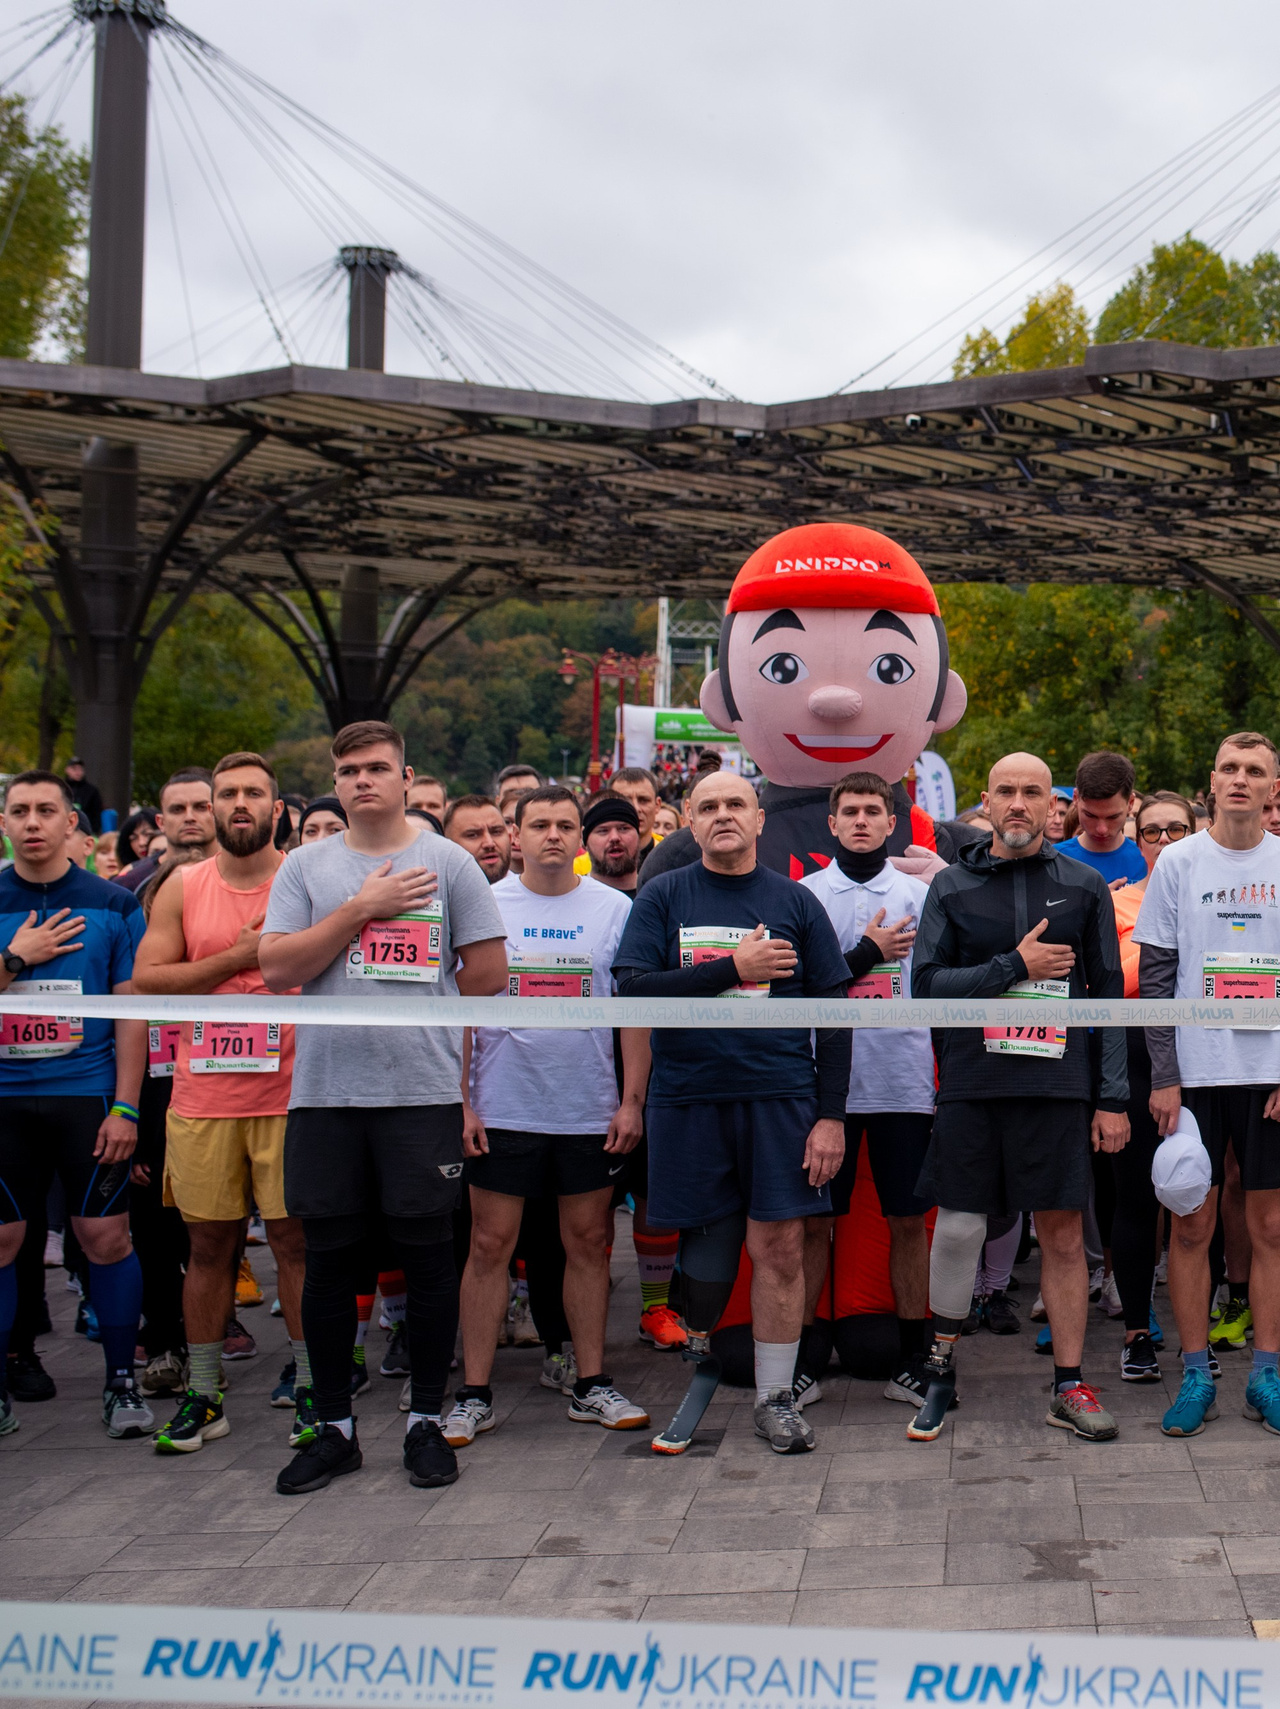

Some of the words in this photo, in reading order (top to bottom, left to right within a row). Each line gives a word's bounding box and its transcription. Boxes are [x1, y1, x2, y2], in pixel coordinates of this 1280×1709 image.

[775, 557, 878, 573] DNIPRO
[1217, 911, 1262, 920] superhumans
[523, 928, 538, 938] BE
[350, 951, 362, 965] C
[369, 942, 417, 963] 1753
[373, 967, 421, 977] ПриватБанк
[11, 1023, 59, 1043] 1605
[211, 1037, 254, 1056] 1701
[1007, 1044, 1051, 1054] ПриватБанк
[142, 1637, 261, 1679] RUN
[522, 1650, 640, 1693] RUN
[905, 1662, 1022, 1704] RUN
